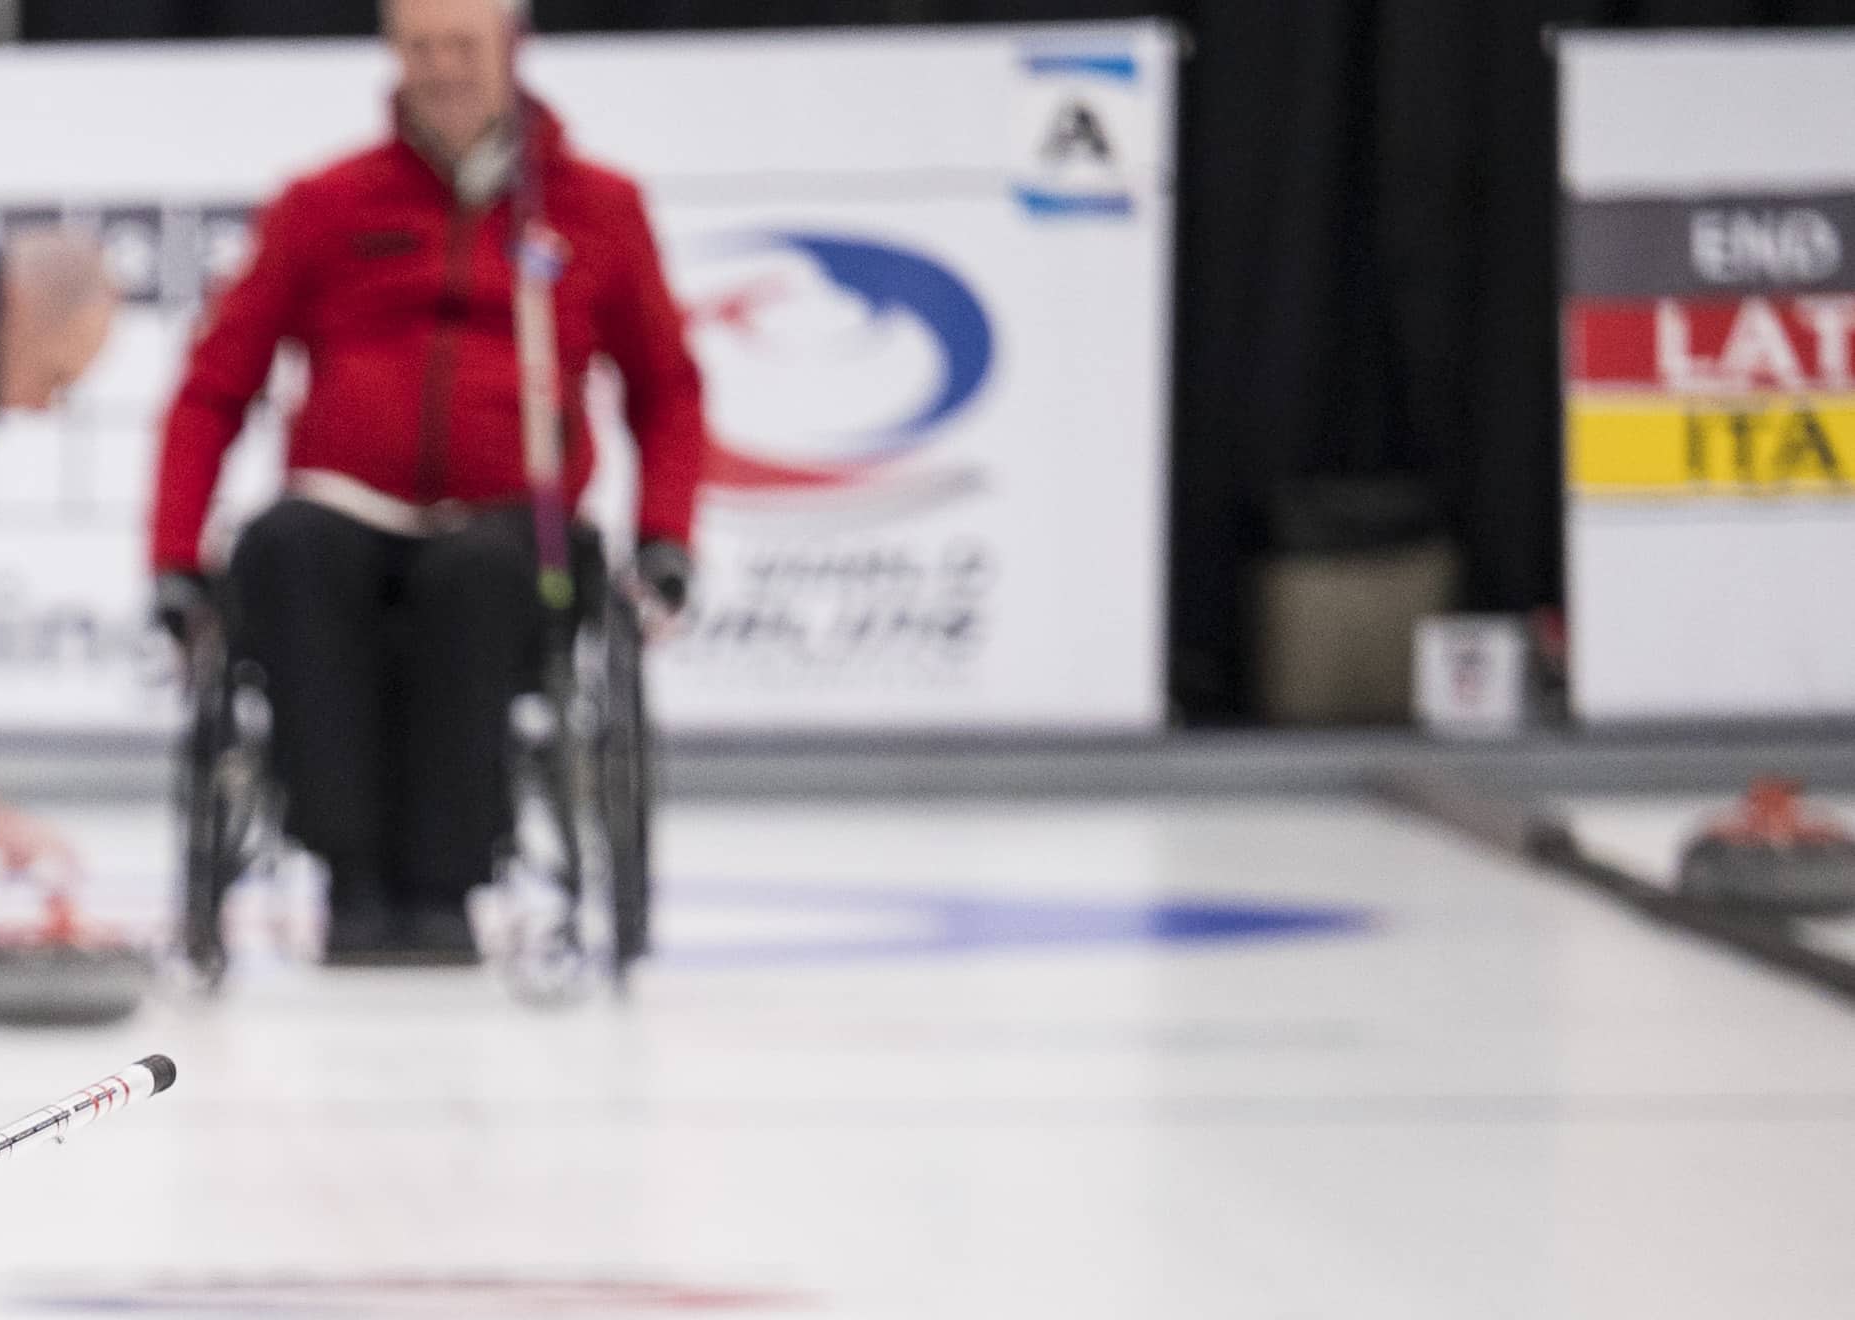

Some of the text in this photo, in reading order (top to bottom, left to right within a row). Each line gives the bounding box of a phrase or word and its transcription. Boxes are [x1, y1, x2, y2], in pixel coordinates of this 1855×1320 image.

[1039, 97, 1113, 164] A
[1691, 208, 1840, 282] END
[1657, 293, 1855, 393] LAT
[1684, 407, 1842, 486] ITA
